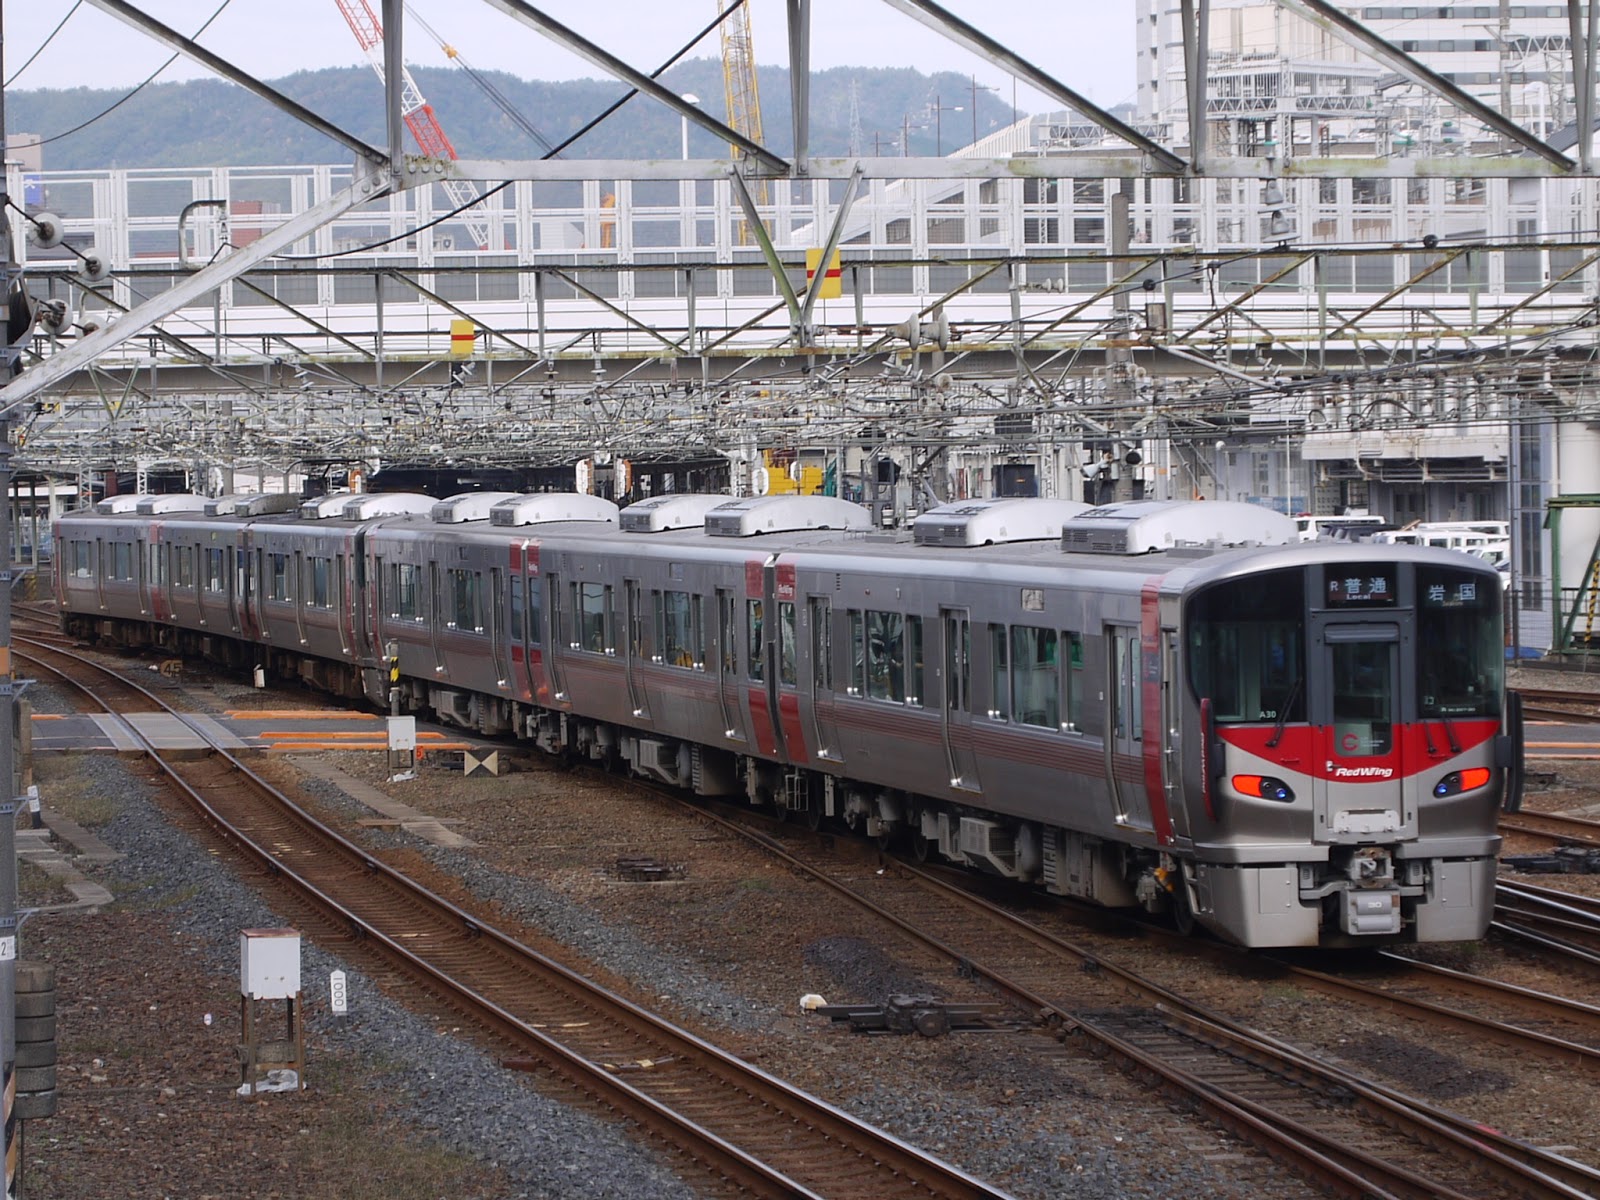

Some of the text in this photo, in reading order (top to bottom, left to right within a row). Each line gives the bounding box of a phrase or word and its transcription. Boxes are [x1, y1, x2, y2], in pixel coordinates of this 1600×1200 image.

[1330, 577, 1387, 594] R 普通
[1429, 583, 1476, 601] 岩国
[1260, 710, 1277, 718] A30
[1336, 767, 1393, 778] RedWing
[333, 977, 344, 1007] 1000
